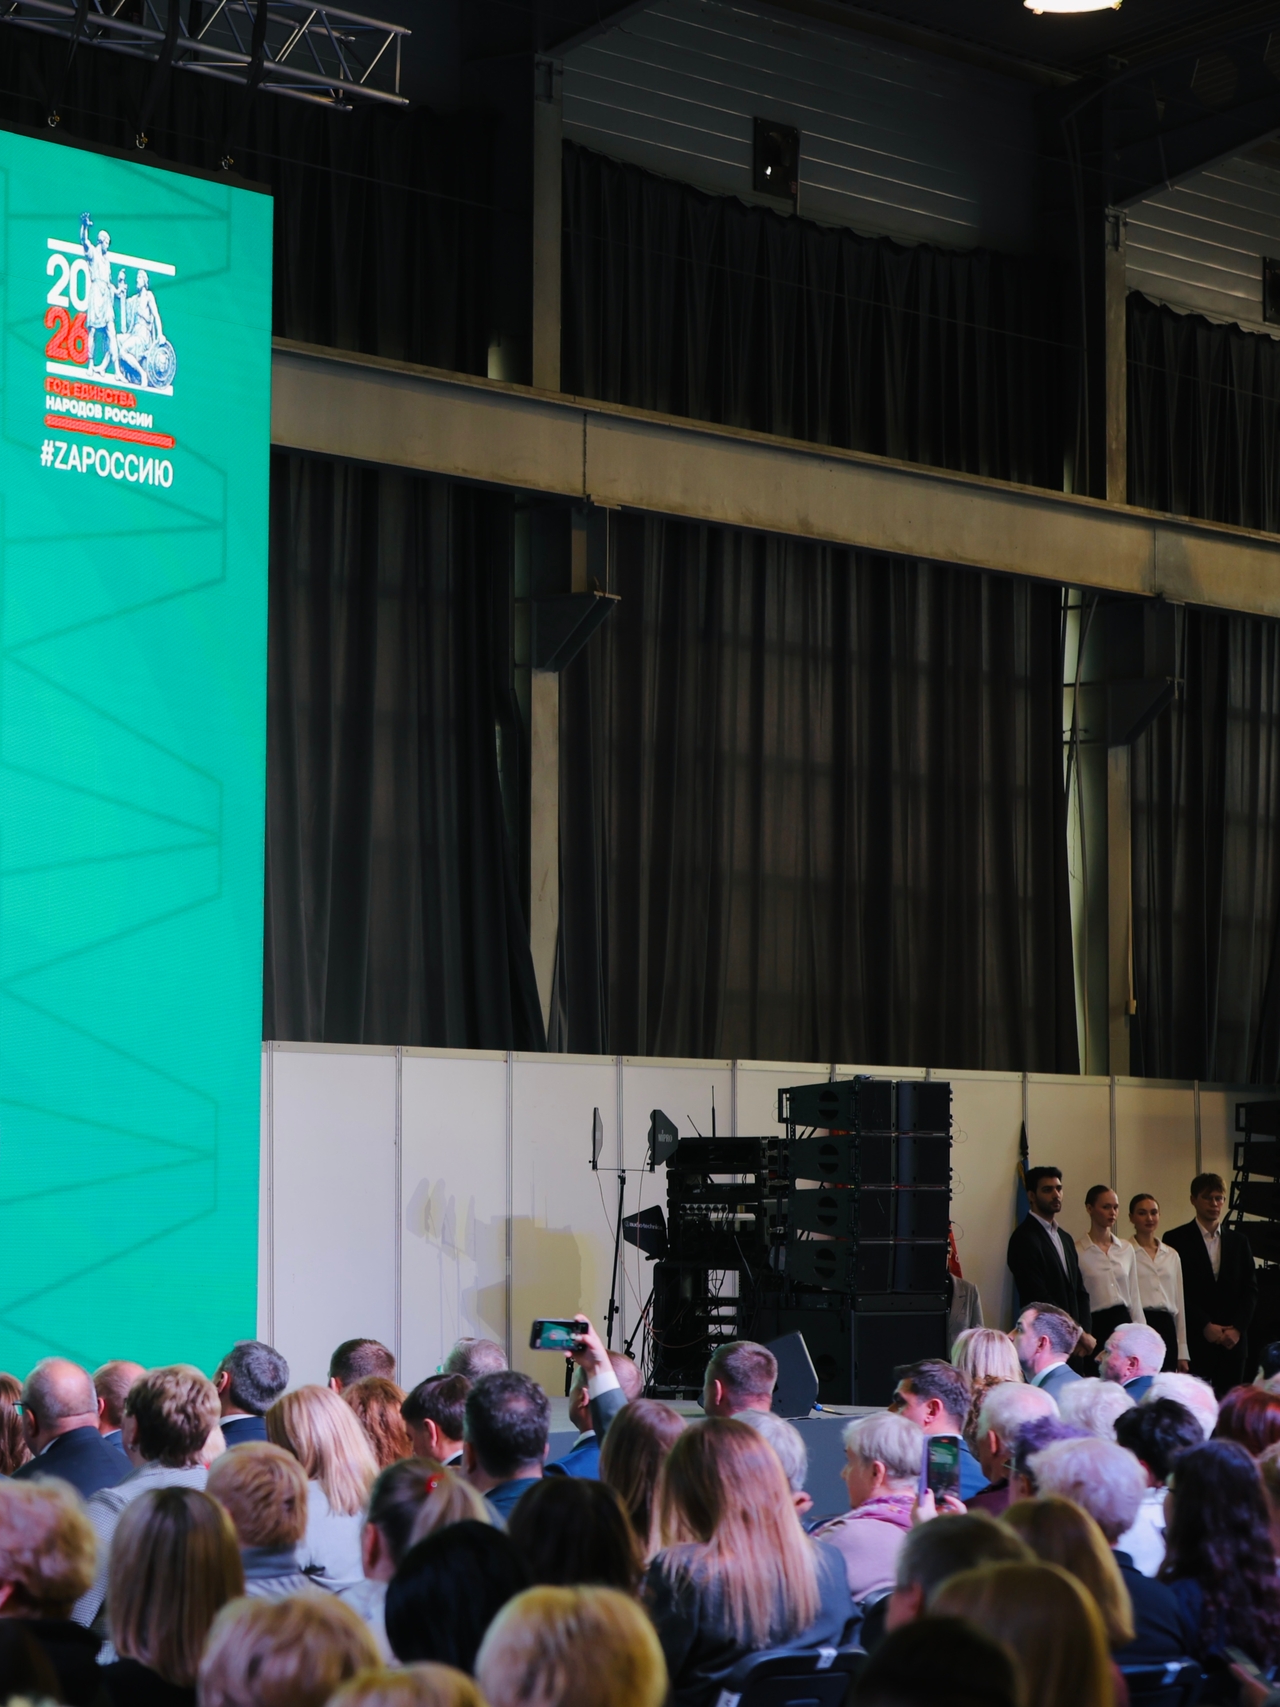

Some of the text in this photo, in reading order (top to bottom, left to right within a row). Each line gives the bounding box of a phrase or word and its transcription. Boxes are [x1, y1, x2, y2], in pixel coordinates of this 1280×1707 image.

[46, 253, 90, 311] 20
[45, 306, 89, 364] 26
[45, 394, 153, 429] НАРОДОВ РОССИИ
[46, 377, 136, 408] ГОД ЕДИНСТВА
